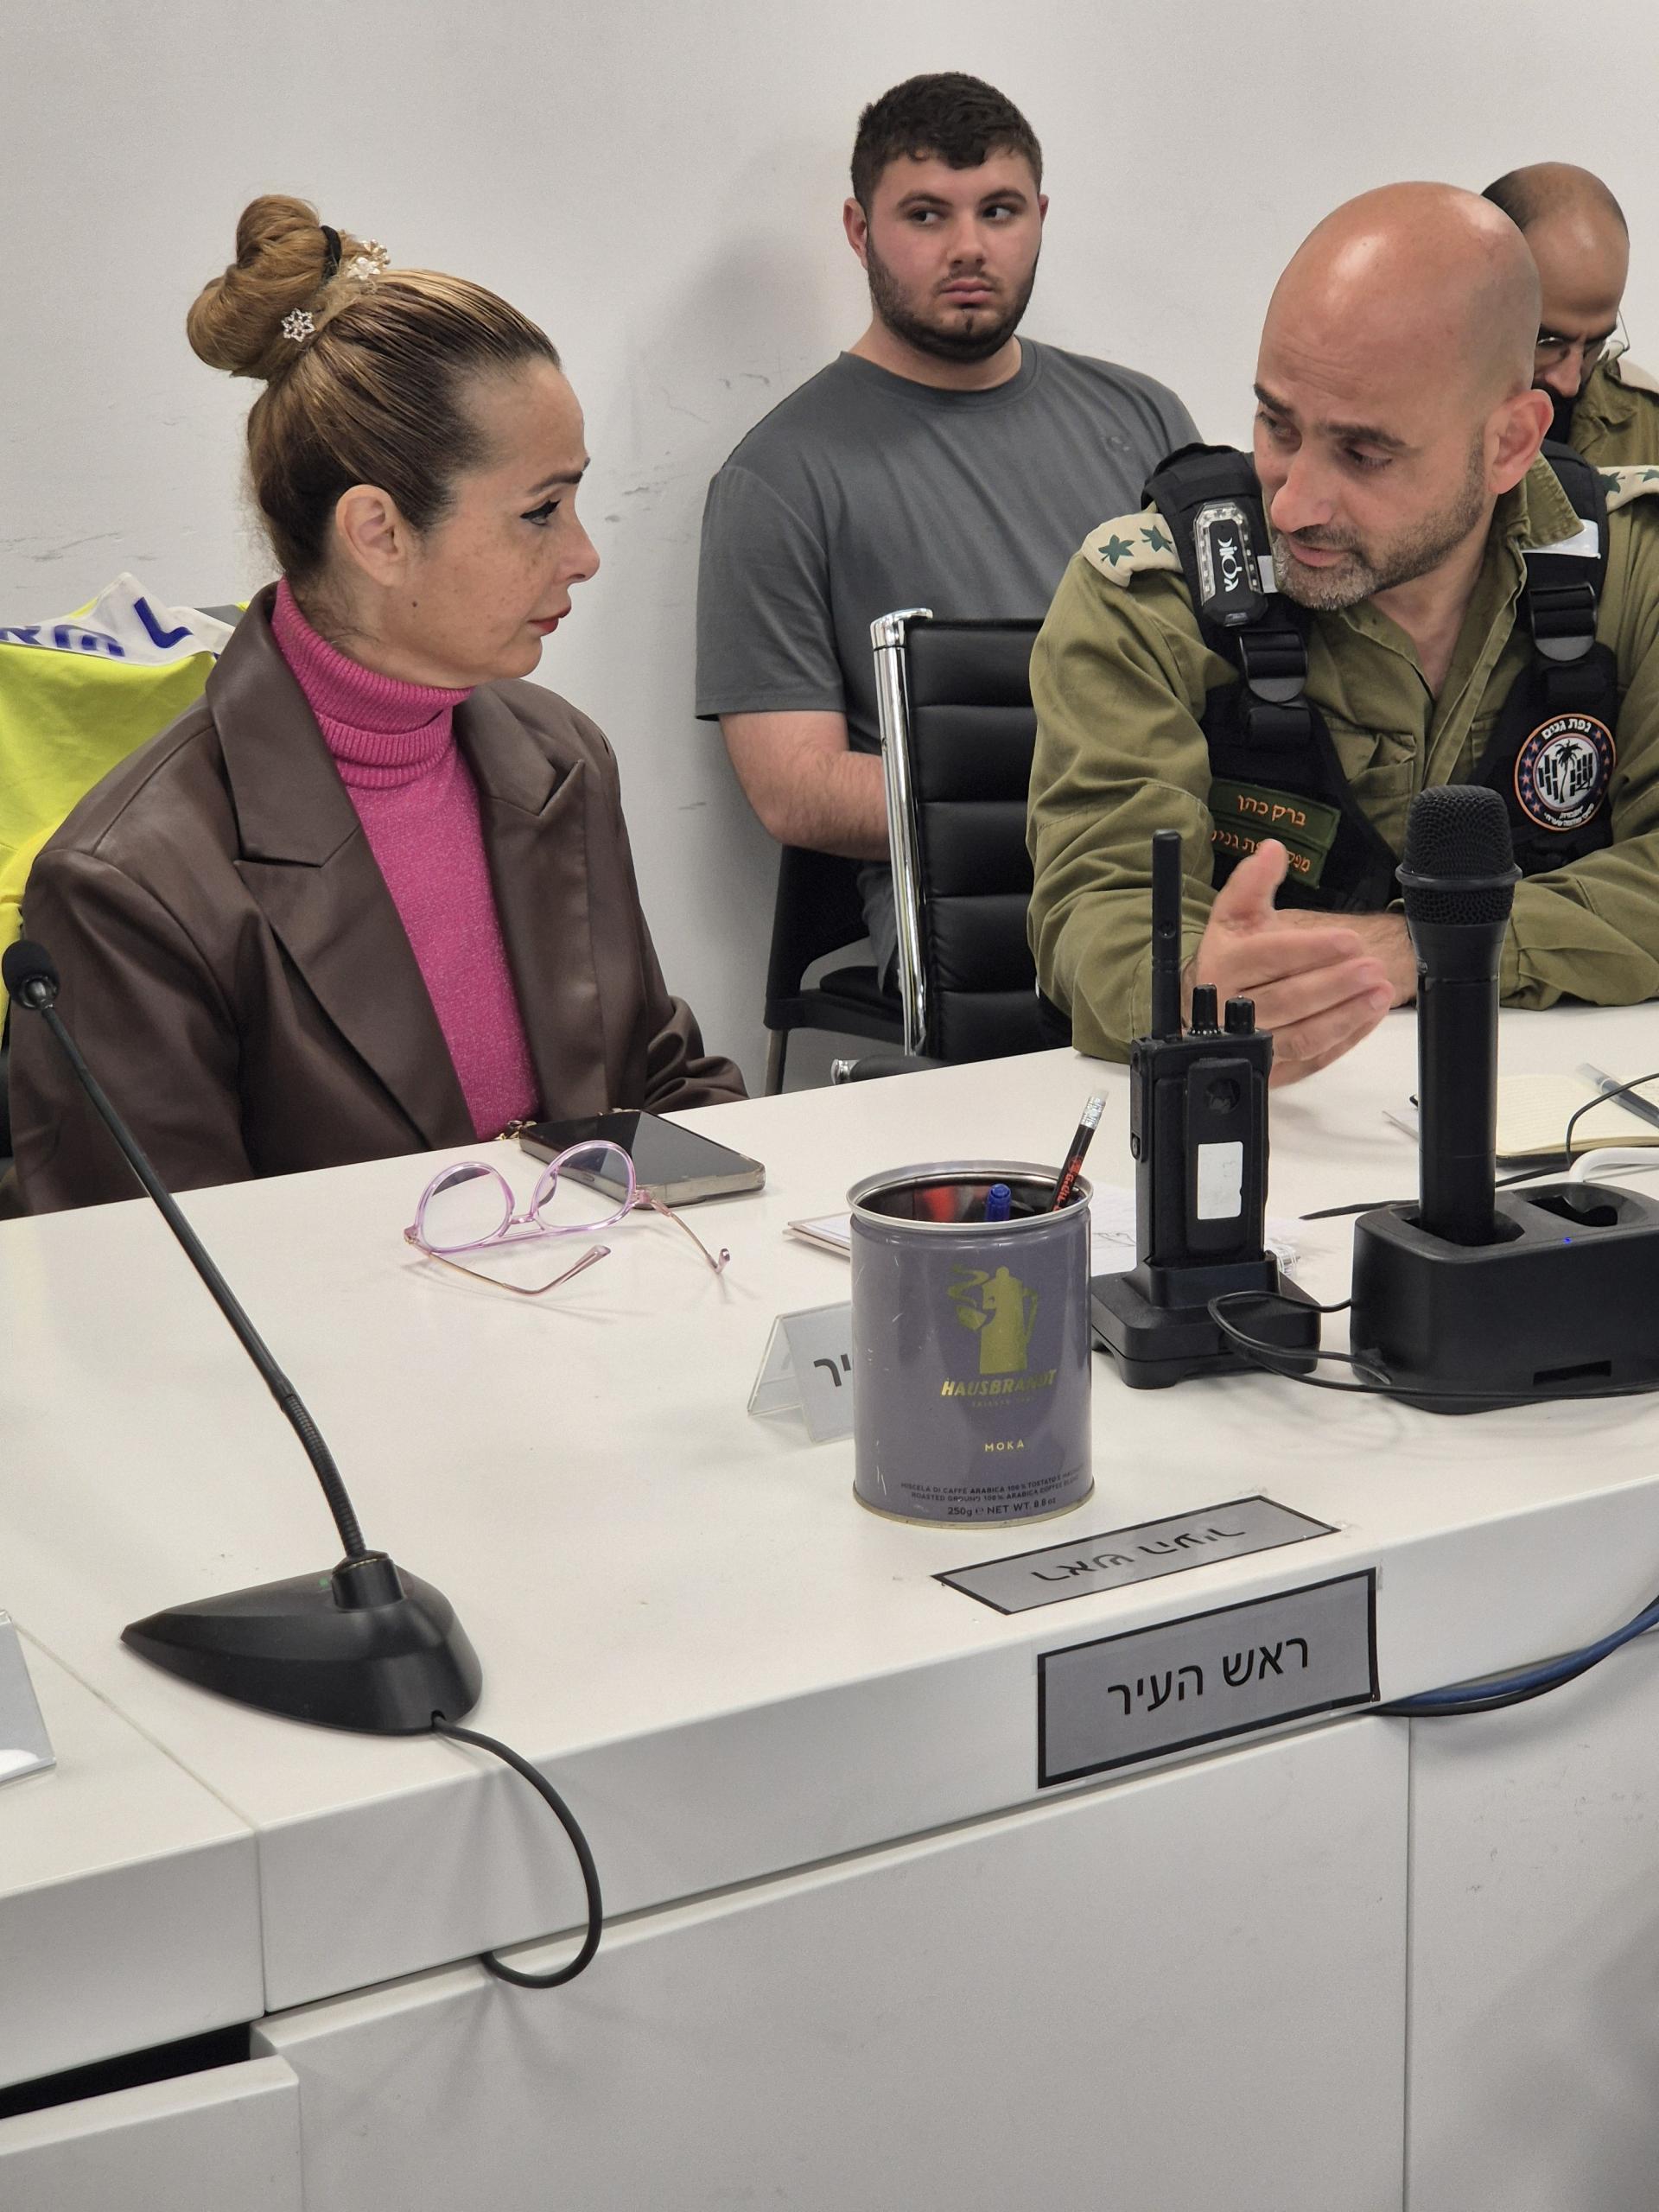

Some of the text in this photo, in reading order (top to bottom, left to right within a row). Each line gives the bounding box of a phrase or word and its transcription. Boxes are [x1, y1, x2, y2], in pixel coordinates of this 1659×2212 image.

[1567, 718, 1592, 733] נפת
[1236, 794, 1306, 826] ברק כהן
[940, 1369, 1058, 1397] HAUSBRANDT
[984, 1439, 1025, 1452] MOKA
[970, 1485, 1005, 1495] ARABICA
[1006, 1489, 1039, 1500] ARABICA
[947, 1506, 973, 1517] 250g
[987, 1504, 1009, 1514] NET
[1107, 1637, 1308, 1716] ראש העיר
